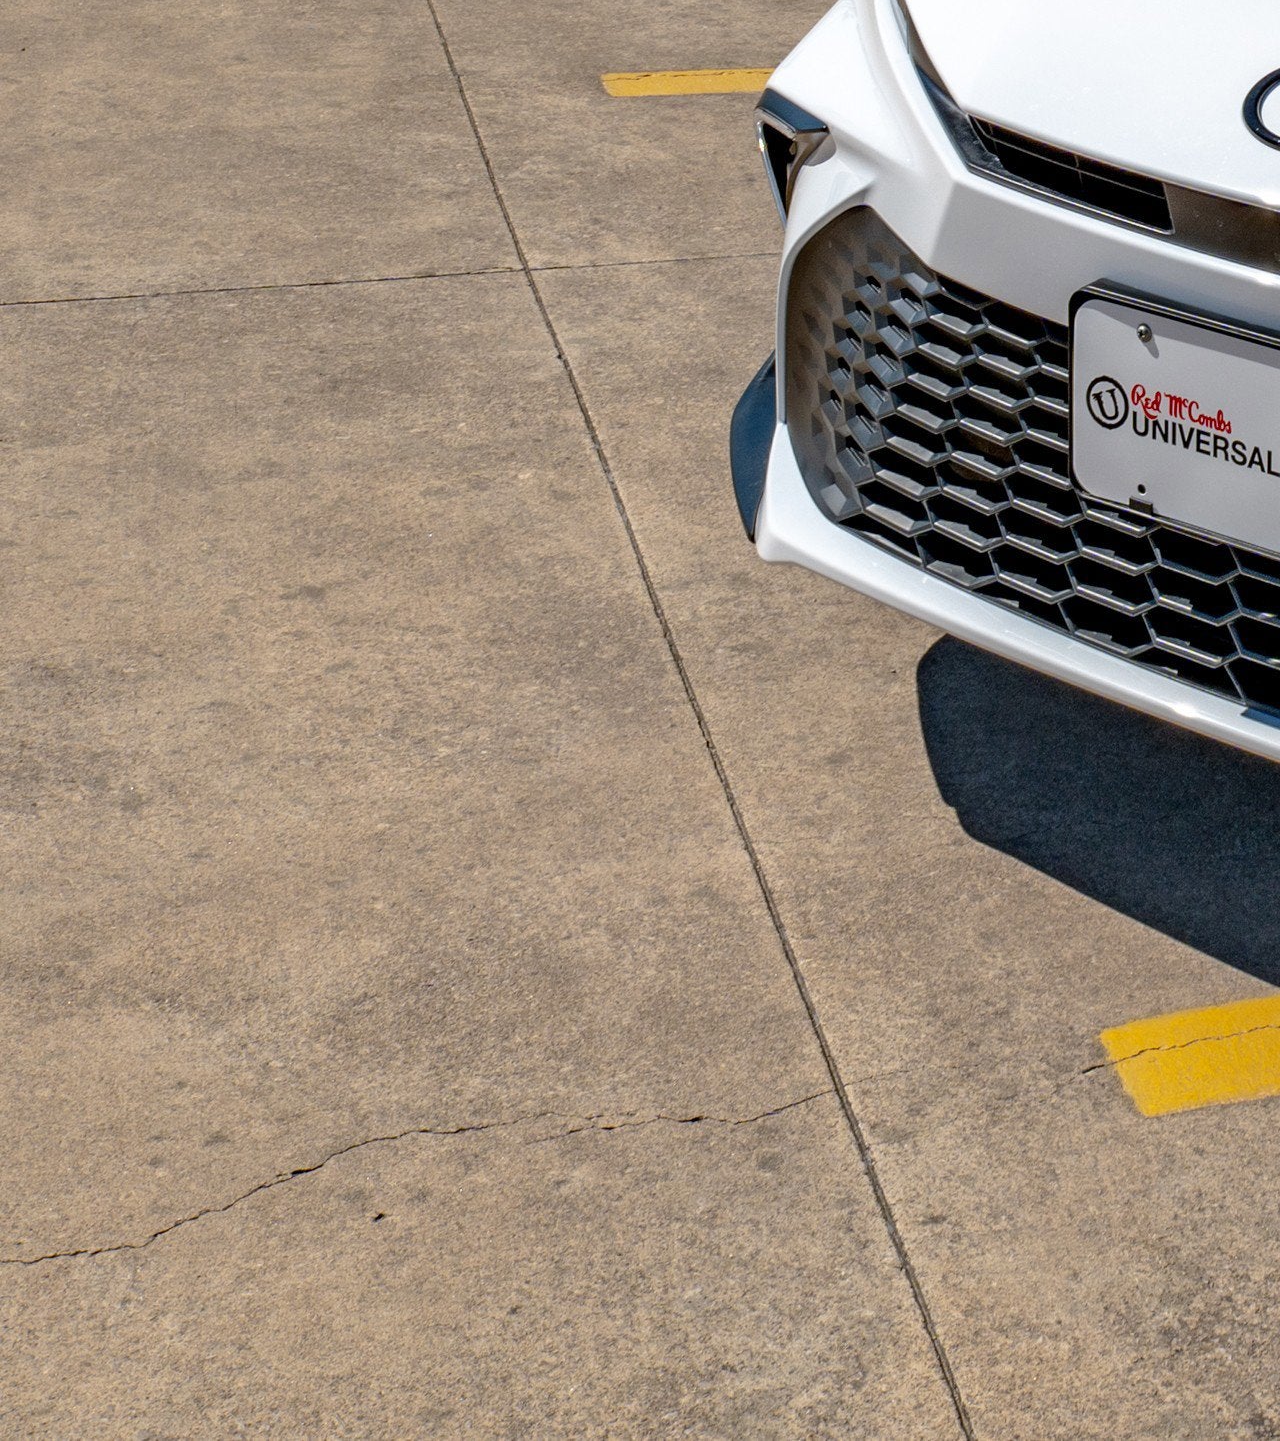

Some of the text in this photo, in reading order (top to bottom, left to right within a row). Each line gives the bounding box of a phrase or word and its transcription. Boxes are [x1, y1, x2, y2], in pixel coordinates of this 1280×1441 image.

[1131, 383, 1232, 434] Red McCombs
[1132, 410, 1280, 478] UNIVERSAL
